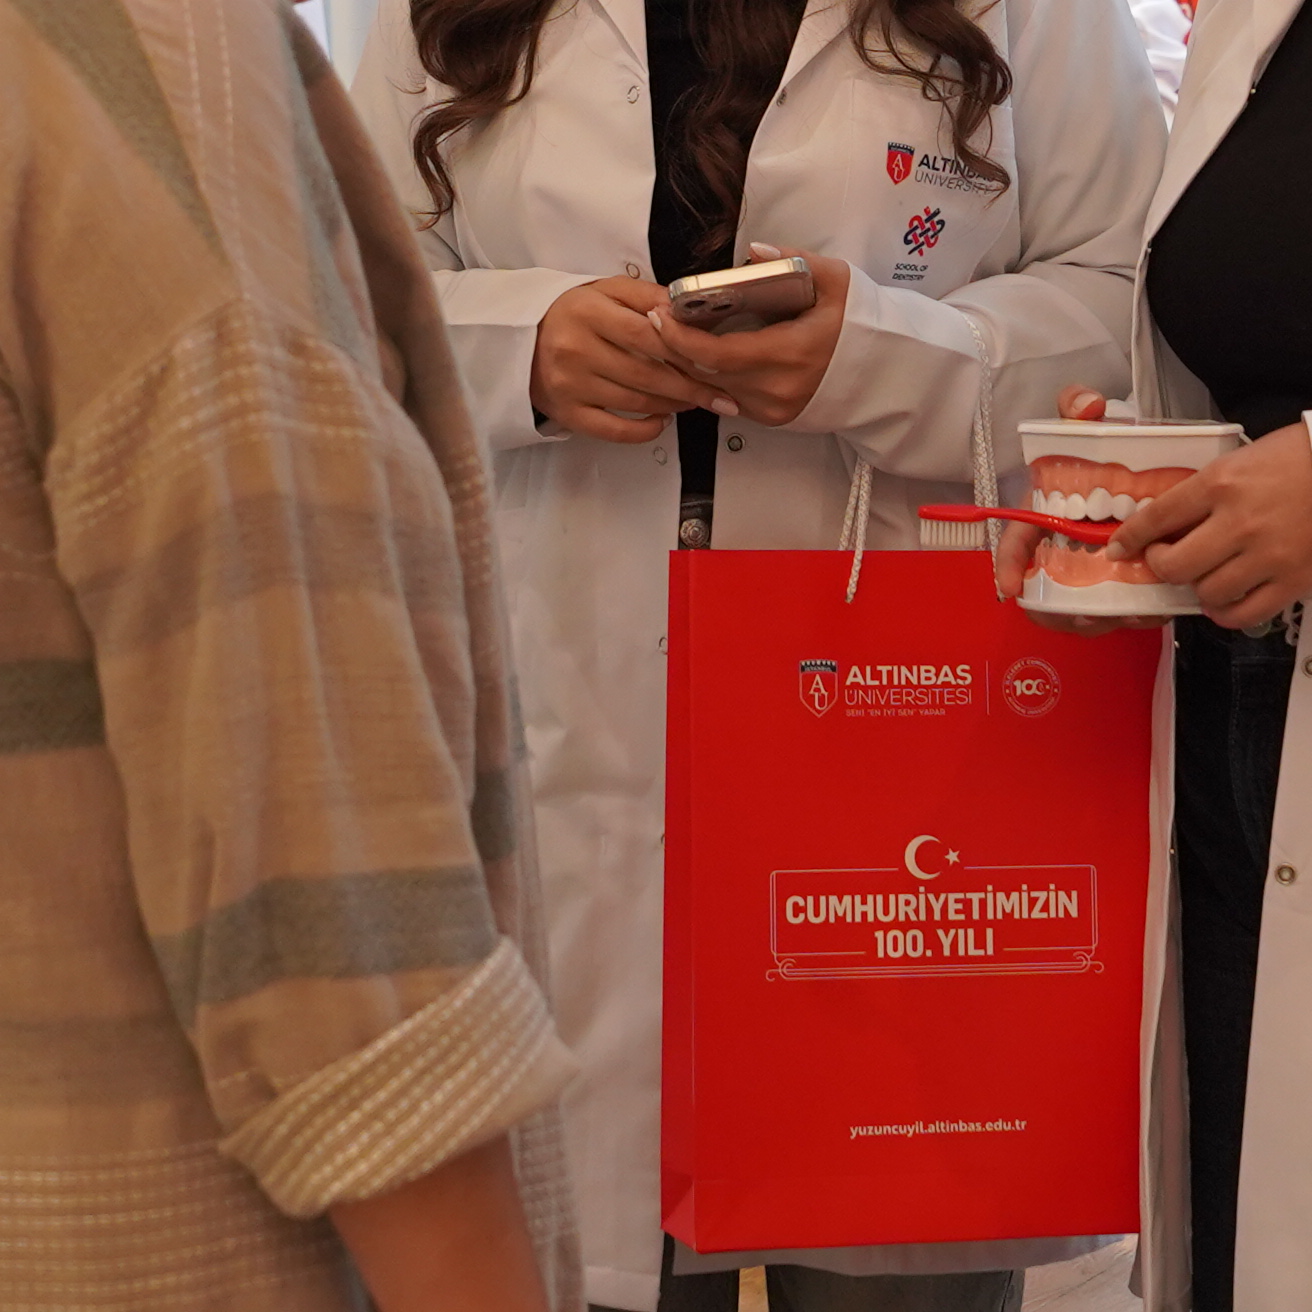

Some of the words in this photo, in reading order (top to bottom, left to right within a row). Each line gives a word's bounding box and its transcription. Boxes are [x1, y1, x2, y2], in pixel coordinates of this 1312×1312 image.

[786, 884, 1079, 924] CUMHURİYETİMİZİN
[874, 929, 932, 958] 100.
[936, 927, 994, 956] YILI
[849, 1119, 1028, 1139] yuzuncuyil.altinbas.edu.tr
